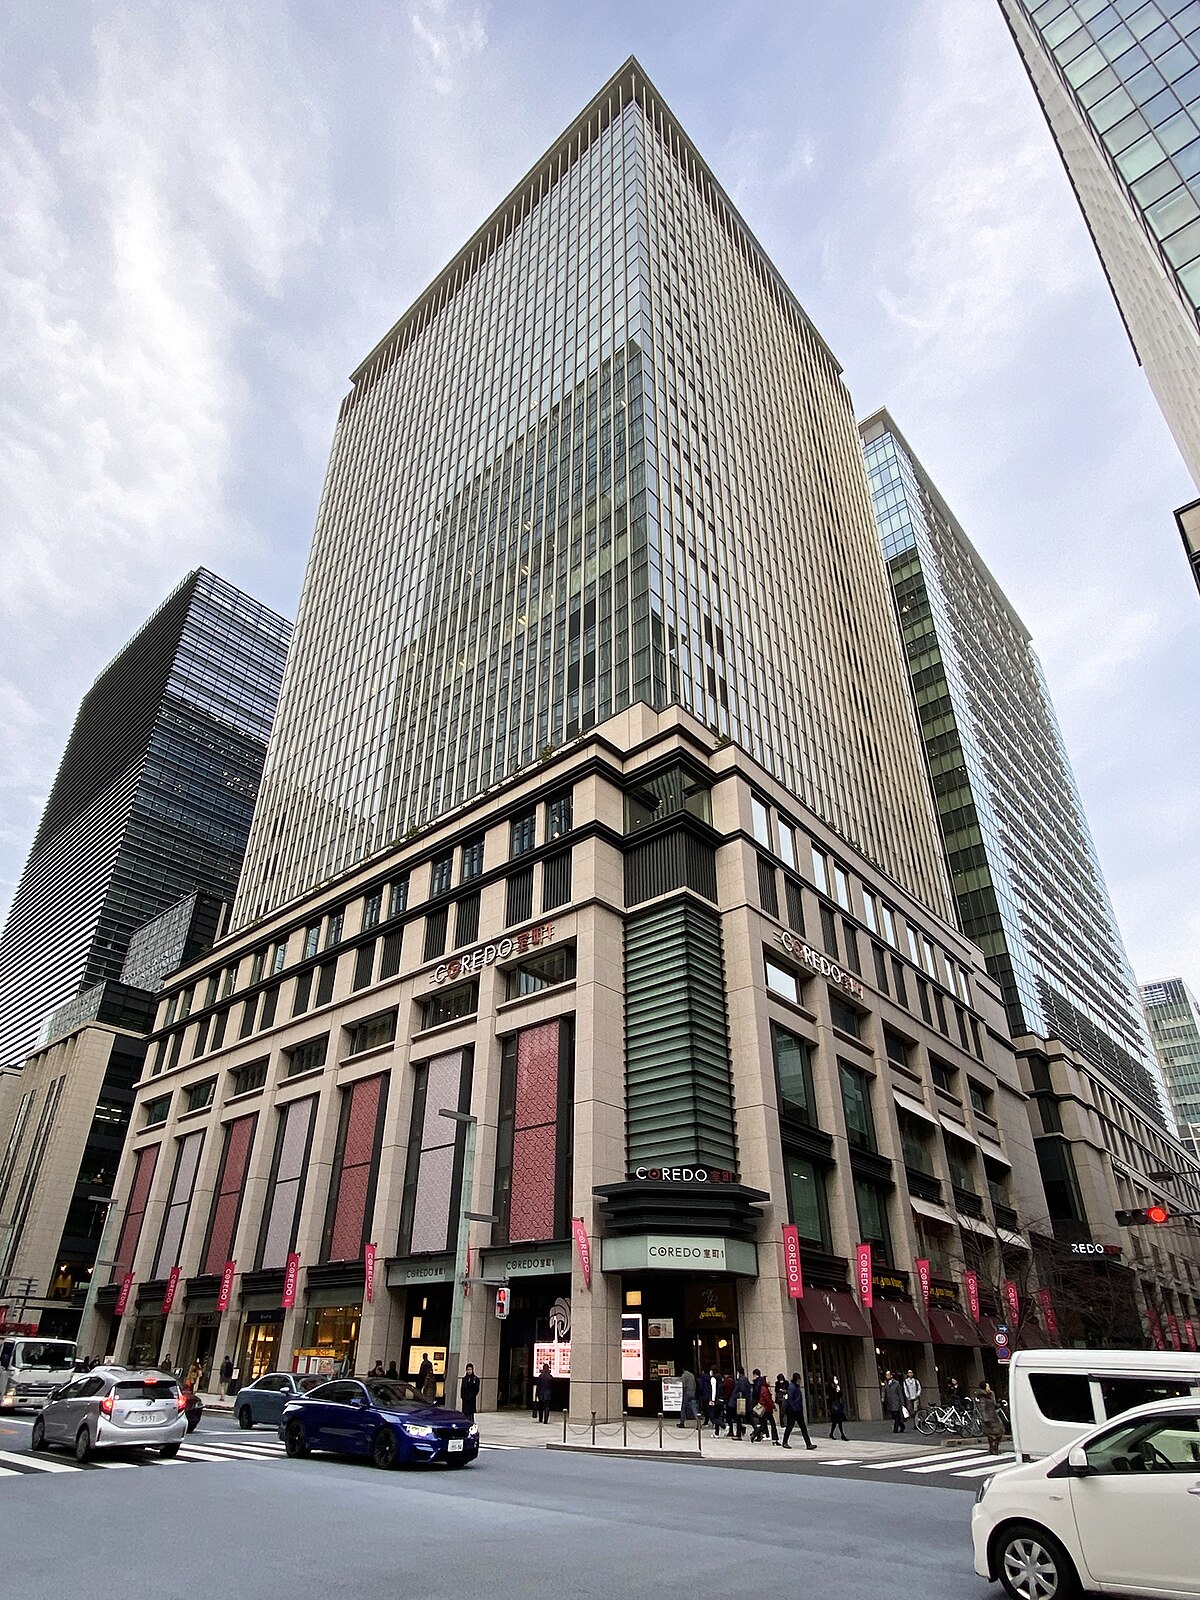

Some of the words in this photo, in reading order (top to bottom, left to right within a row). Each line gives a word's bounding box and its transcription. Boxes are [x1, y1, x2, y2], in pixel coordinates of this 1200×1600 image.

[434, 938, 512, 983] COREDO
[781, 931, 842, 983] COREDO
[635, 1166, 708, 1182] COREDO
[506, 1258, 540, 1271] COREDO
[577, 1228, 590, 1273] COREDO
[649, 1246, 701, 1258] COREDO
[787, 1236, 799, 1282] COREDO
[220, 1268, 232, 1301] COREDO
[285, 1261, 297, 1296] COREDO
[366, 1252, 374, 1290] COREDO
[406, 1269, 434, 1279] COREDO
[860, 1253, 869, 1293] COREDO
[118, 1278, 131, 1306] COREDO
[165, 1273, 178, 1304] COREDO
